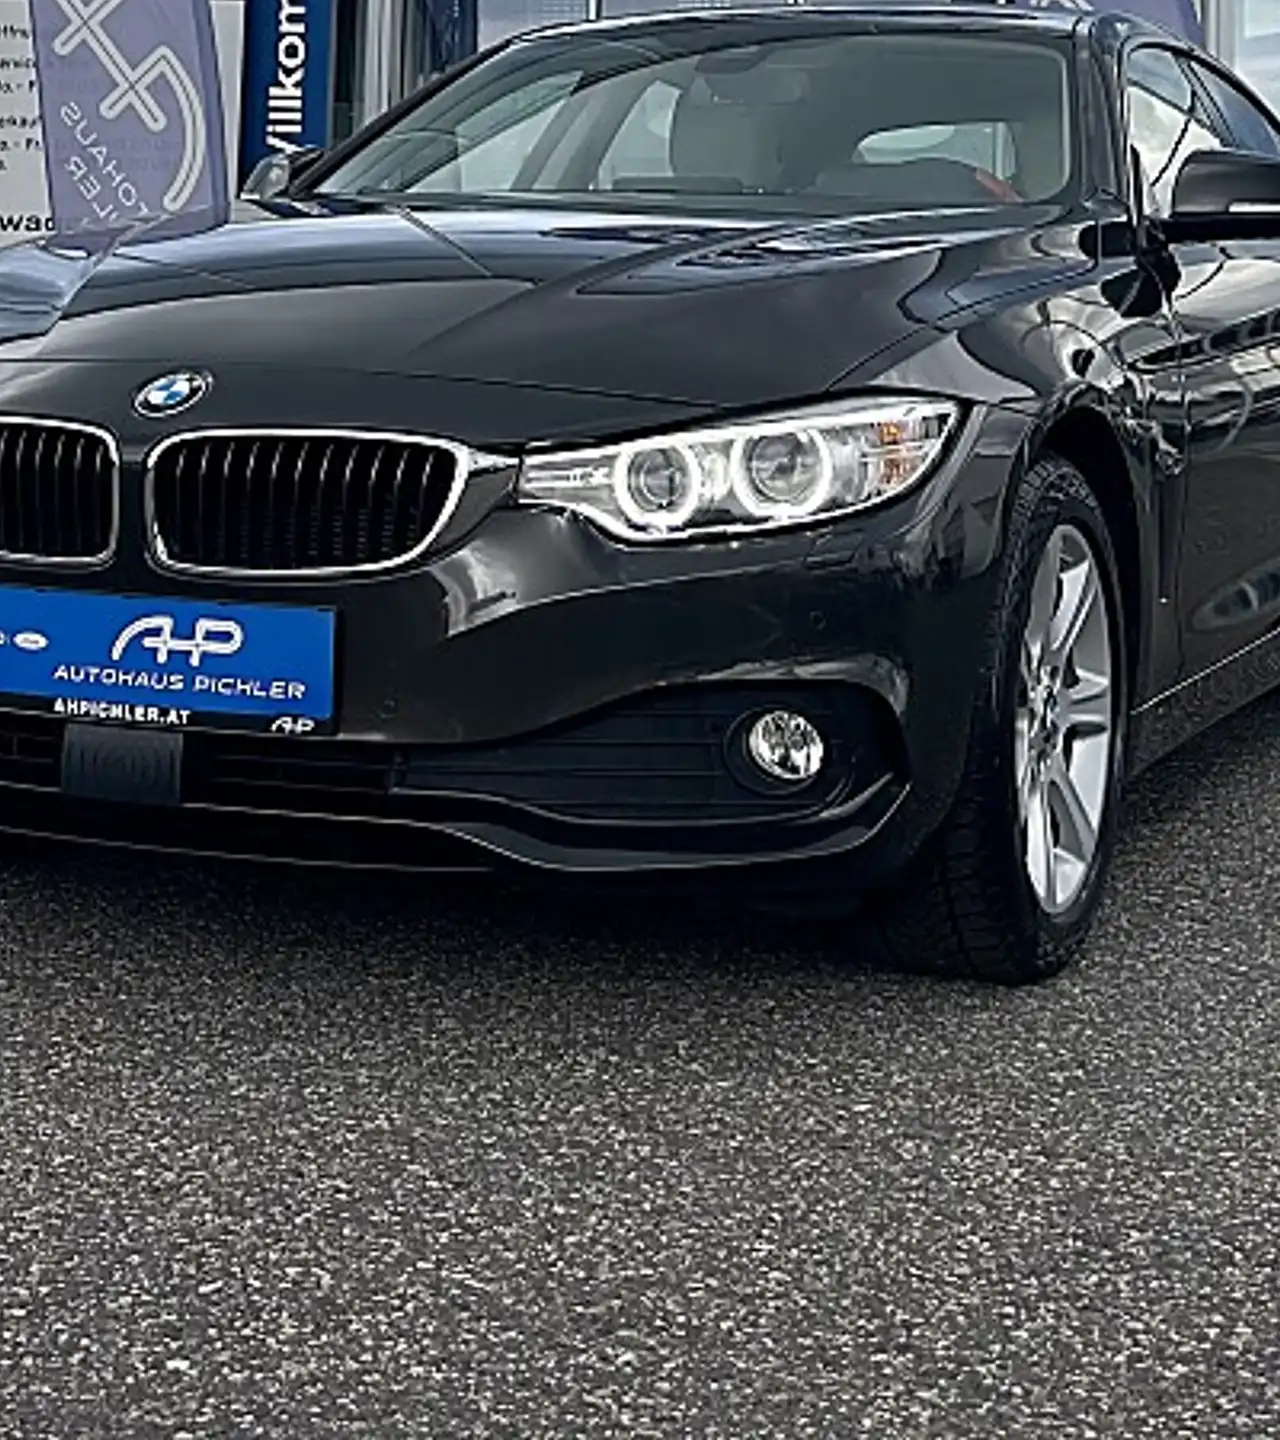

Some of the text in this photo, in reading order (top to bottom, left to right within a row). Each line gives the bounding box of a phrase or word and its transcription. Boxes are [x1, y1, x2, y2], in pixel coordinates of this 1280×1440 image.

[53, 663, 306, 700] AUTOHAUS PICHLER
[53, 696, 192, 726] AHPICHLER.AT
